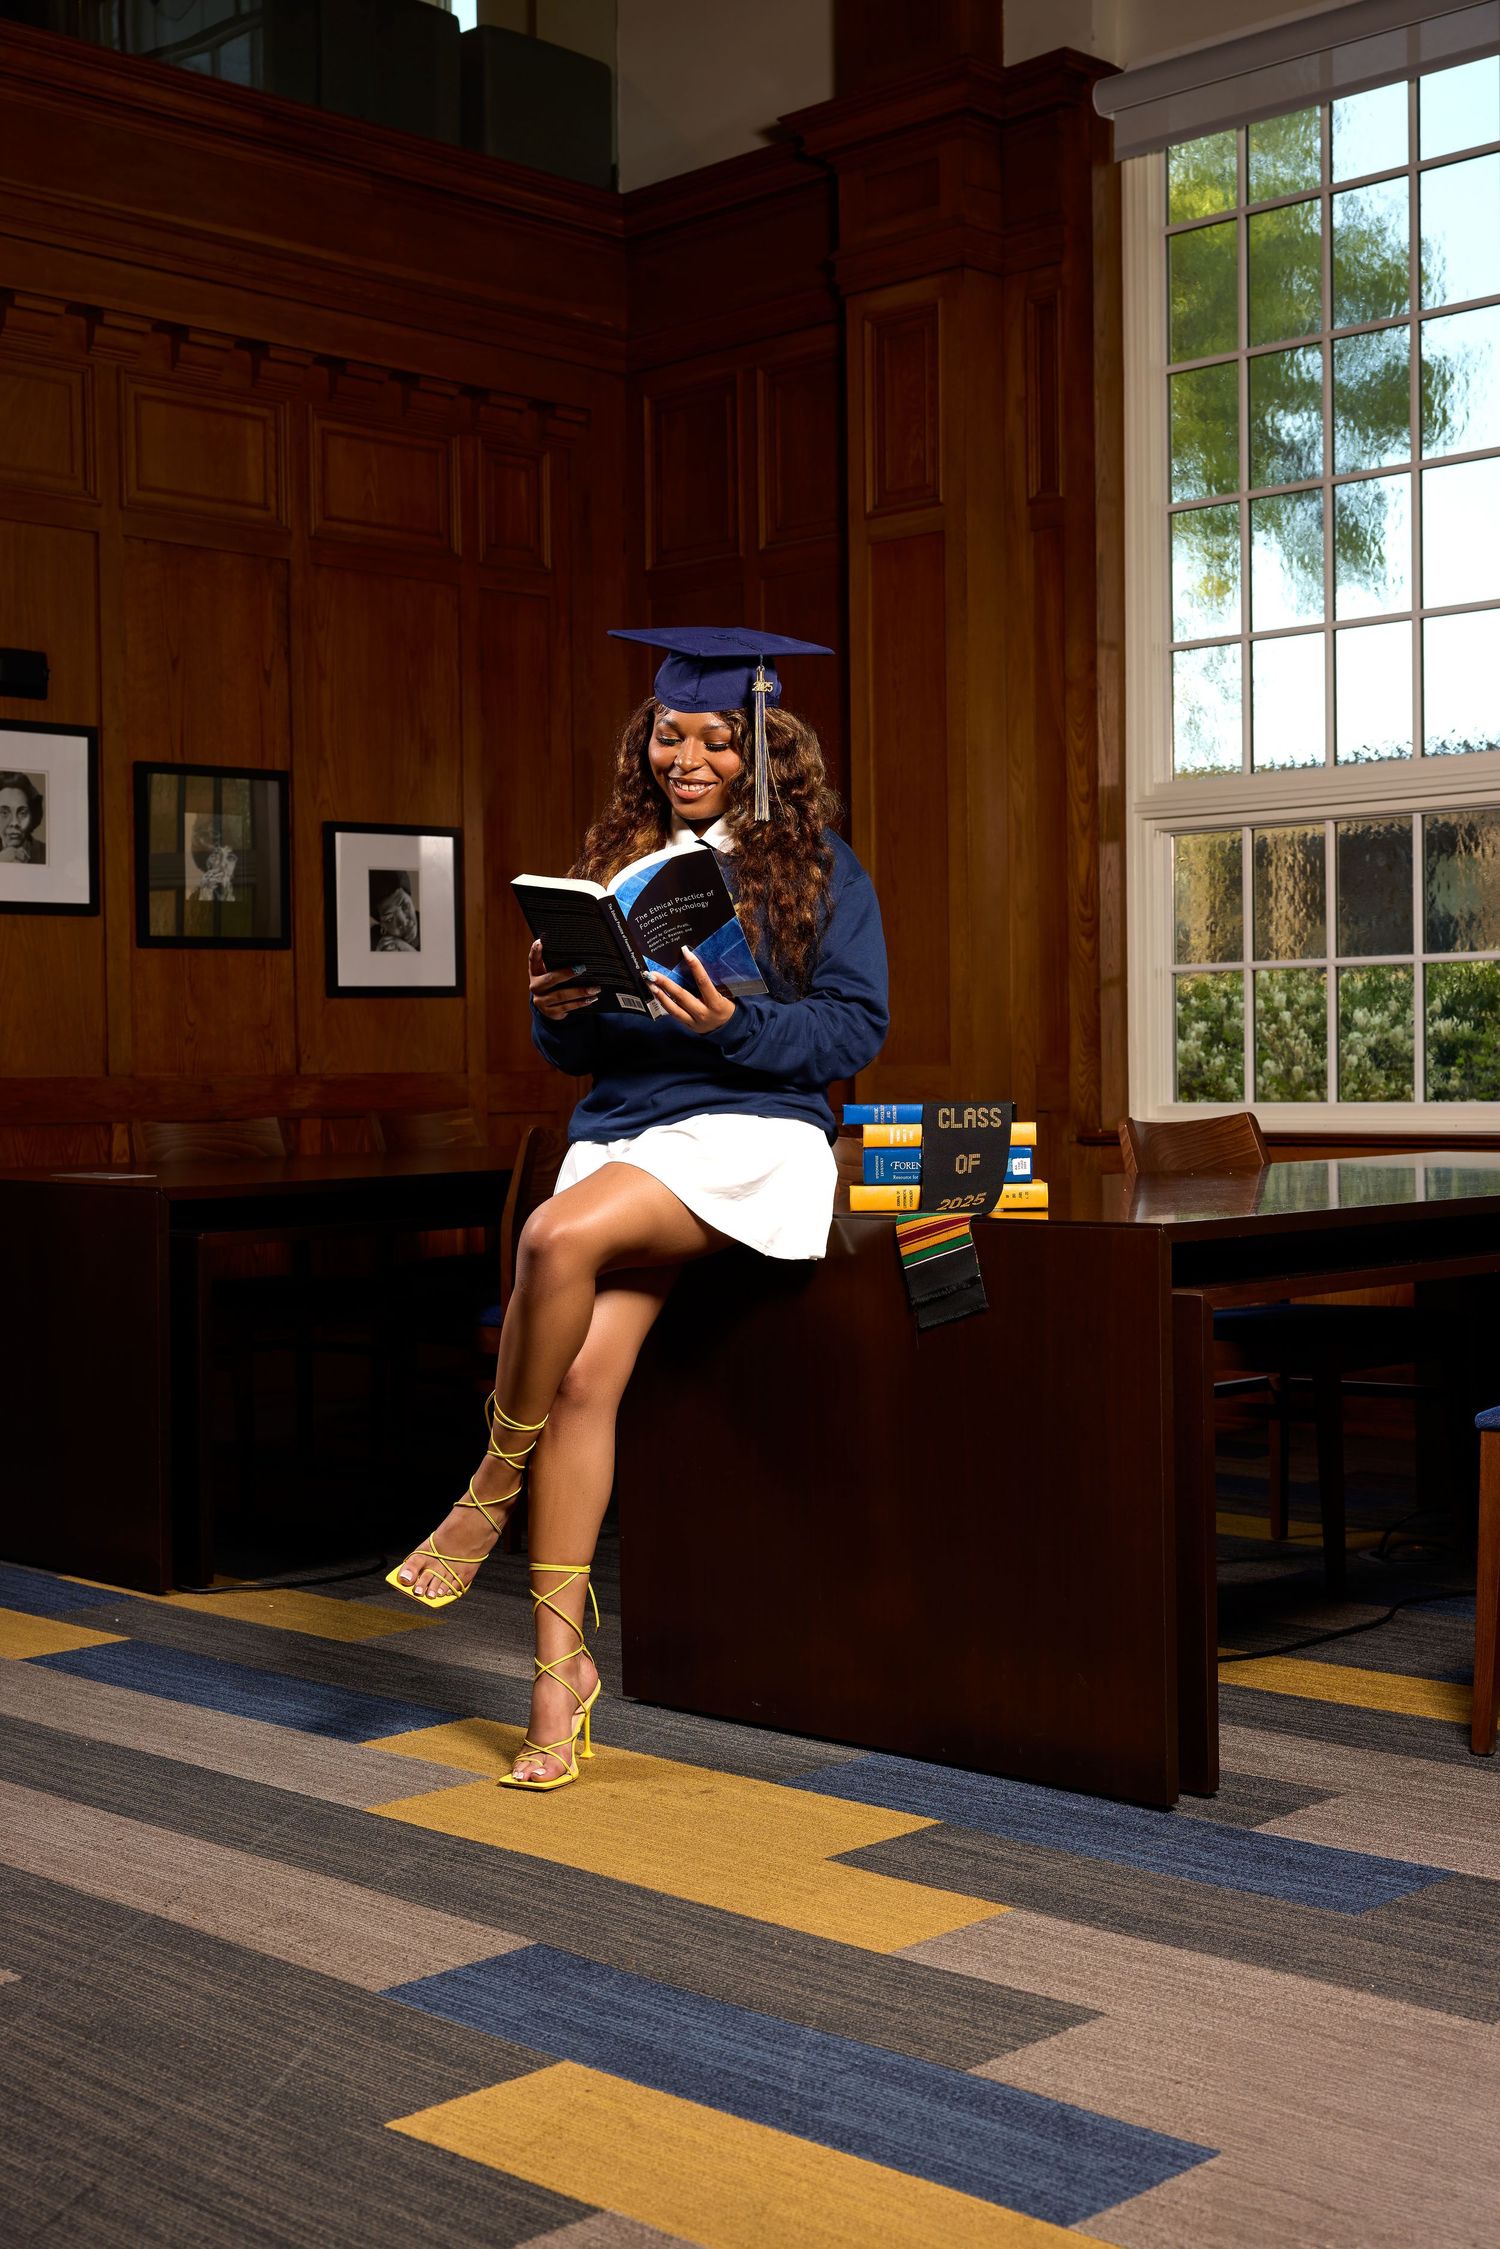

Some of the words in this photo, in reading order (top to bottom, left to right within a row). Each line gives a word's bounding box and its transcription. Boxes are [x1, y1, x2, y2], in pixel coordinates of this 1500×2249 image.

[635, 912, 648, 923] The
[649, 900, 674, 915] Ethical
[675, 893, 705, 903] Practice
[639, 911, 669, 930] Forensic
[669, 901, 709, 914] Psychology
[938, 1107, 1002, 1129] CLASS
[955, 1153, 981, 1175] OF
[936, 1192, 987, 1211] 2025
